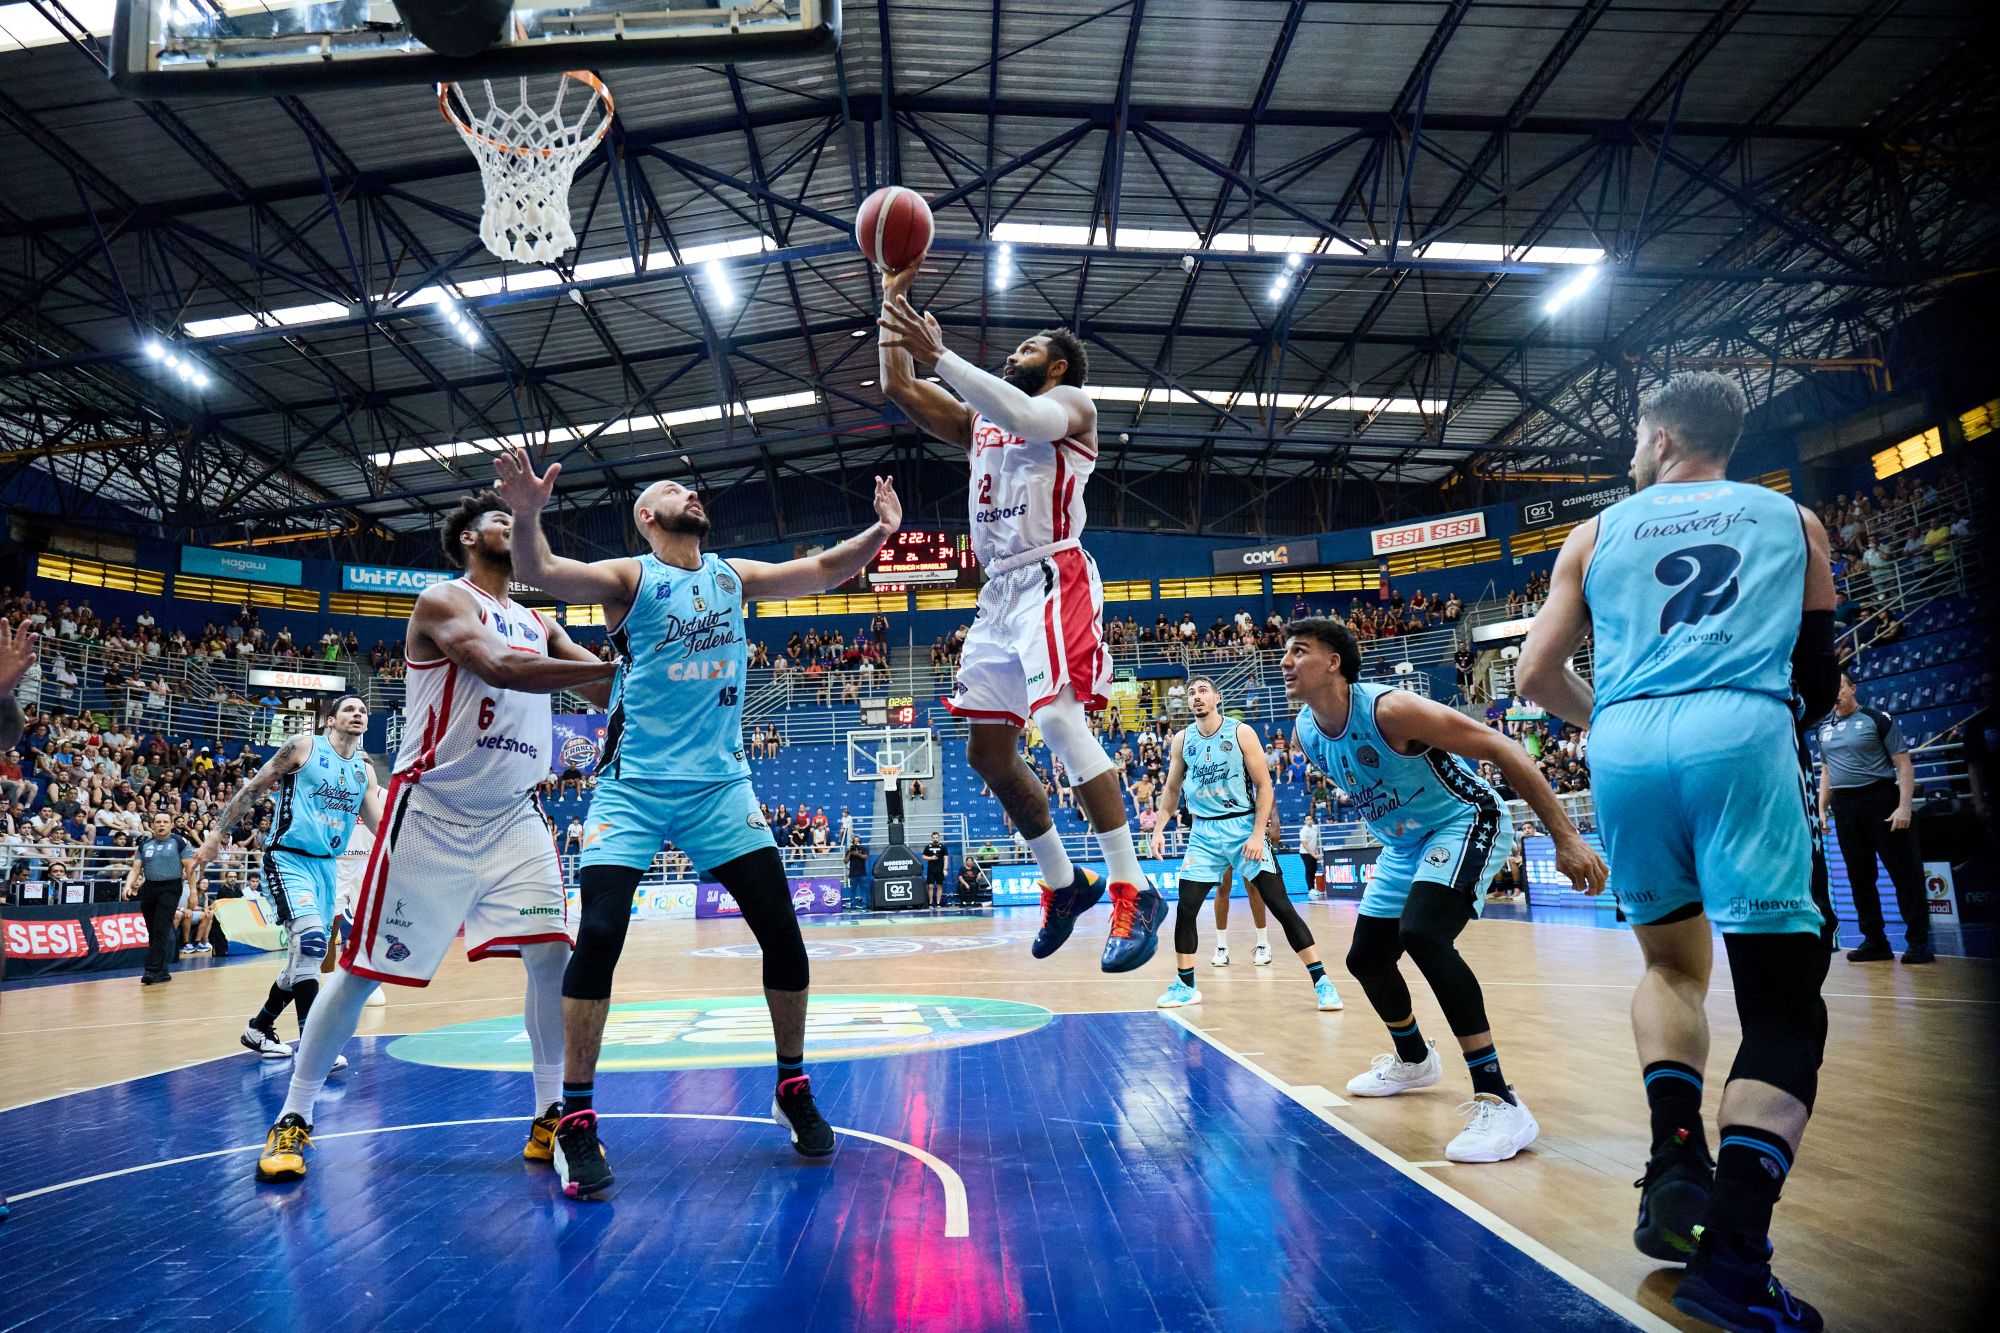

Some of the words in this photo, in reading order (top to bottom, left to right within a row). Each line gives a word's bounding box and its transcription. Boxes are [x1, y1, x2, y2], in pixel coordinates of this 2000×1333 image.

[1562, 486, 1631, 507] Q2INGRESSOS
[1652, 488, 1734, 505] CAIXA
[976, 503, 1026, 523] etshoes
[1530, 507, 1547, 517] Q2
[1634, 507, 1757, 541] Crescenzi
[1381, 530, 1421, 548] SESI
[1435, 520, 1477, 539] SESI
[880, 550, 894, 561] 32
[938, 548, 953, 559] 34
[1655, 544, 1742, 635] 2
[668, 660, 736, 681] CAIXA
[889, 697, 913, 706] 02:22
[478, 697, 495, 730] 6
[899, 707, 913, 722] 19
[330, 835, 342, 849] 9
[884, 859, 913, 867] INGRESSOS
[890, 885, 905, 894] Q2
[8, 924, 78, 954] SESI
[102, 916, 149, 948] SES
